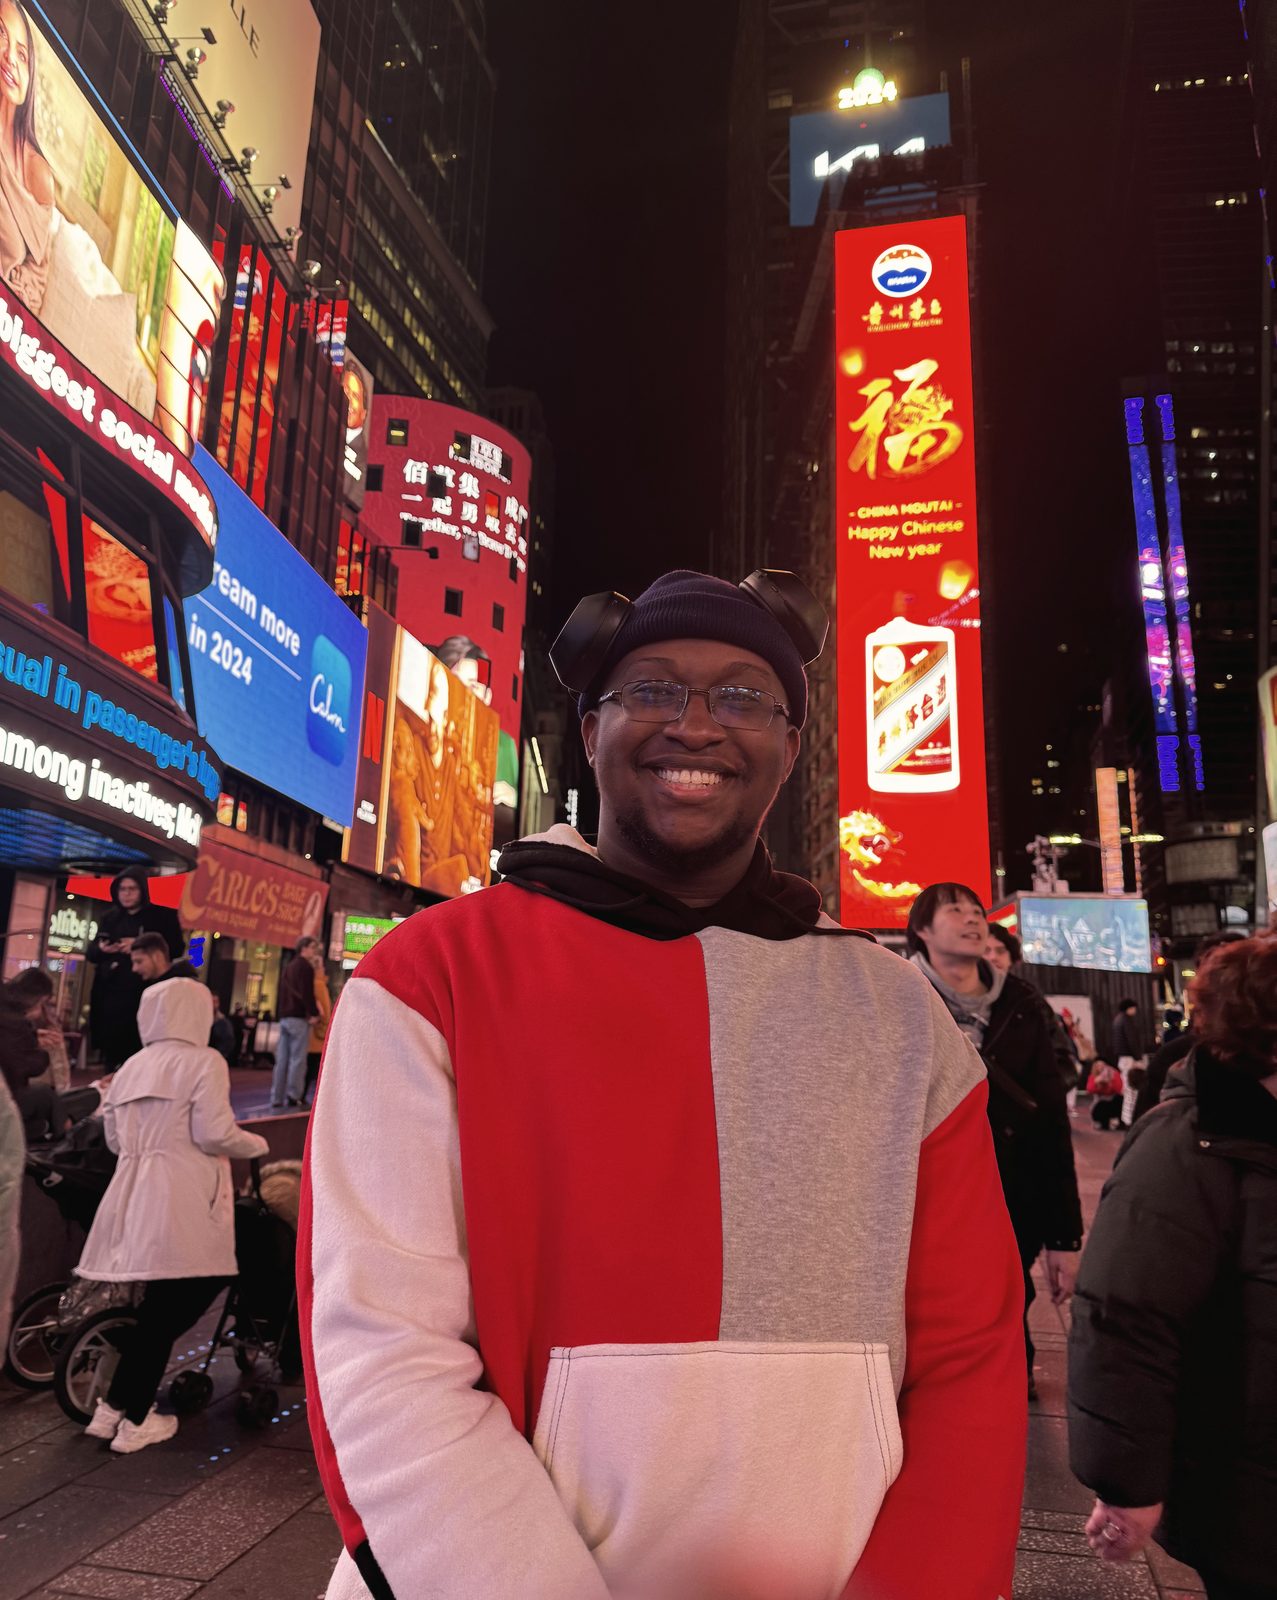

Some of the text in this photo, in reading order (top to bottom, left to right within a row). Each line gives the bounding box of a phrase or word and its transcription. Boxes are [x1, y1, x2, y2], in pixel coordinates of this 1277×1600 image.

[99, 408, 174, 484] social
[848, 520, 964, 541] Happy Chinese
[857, 500, 953, 519] CHINA MOUTAI
[869, 543, 943, 561] New year
[189, 613, 207, 654] in
[209, 630, 253, 685] 2024
[260, 604, 300, 656] more
[54, 663, 82, 713] in
[82, 690, 198, 777] passenger's
[309, 673, 347, 733] Calm
[181, 854, 281, 921] CARLO'S
